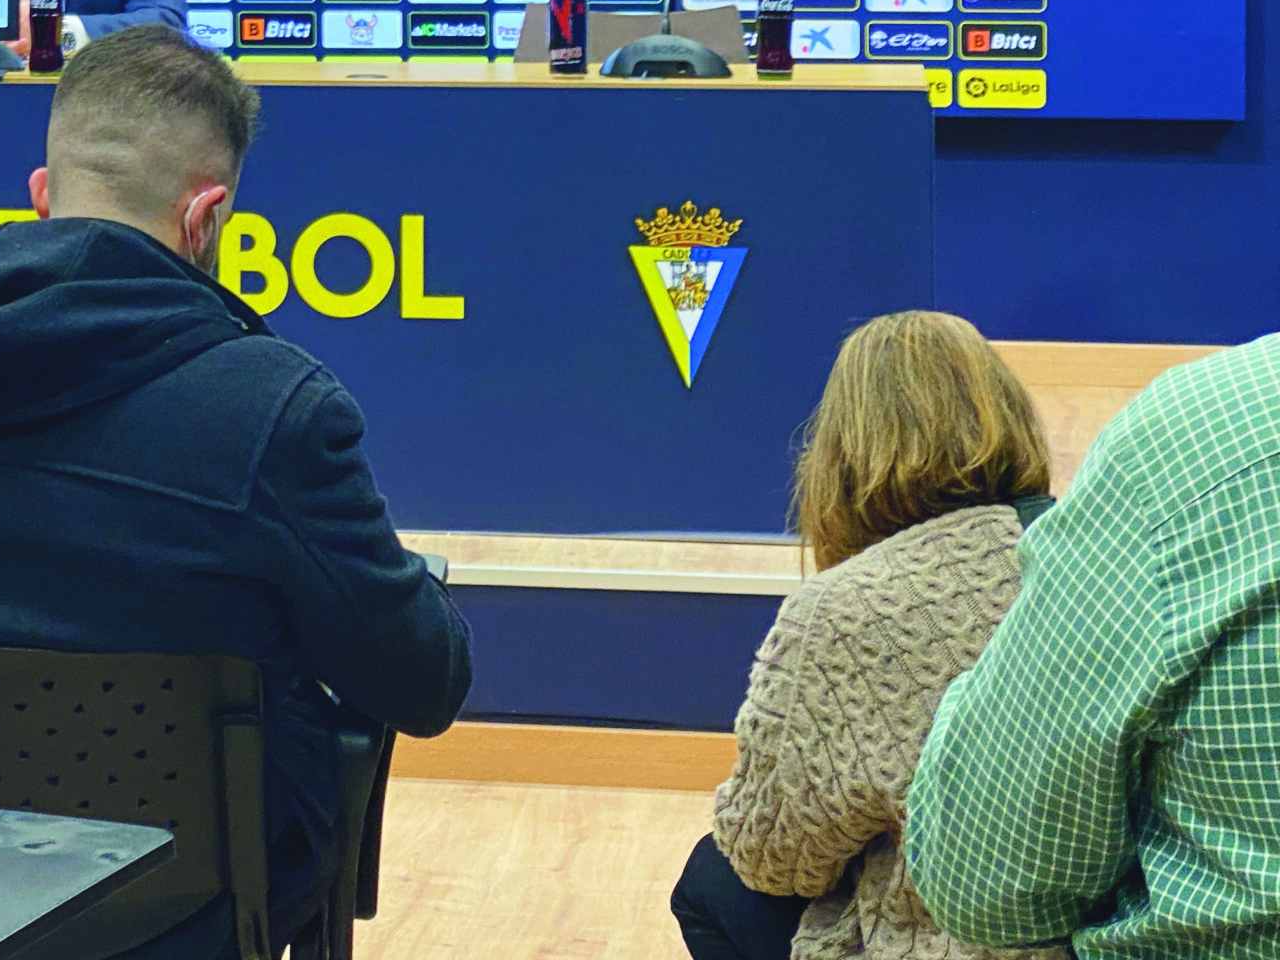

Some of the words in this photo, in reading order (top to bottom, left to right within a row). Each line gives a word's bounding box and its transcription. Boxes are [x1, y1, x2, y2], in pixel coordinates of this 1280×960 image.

[264, 19, 310, 36] Bitci
[991, 32, 1037, 48] Bitci
[991, 80, 1040, 95] LaLiga
